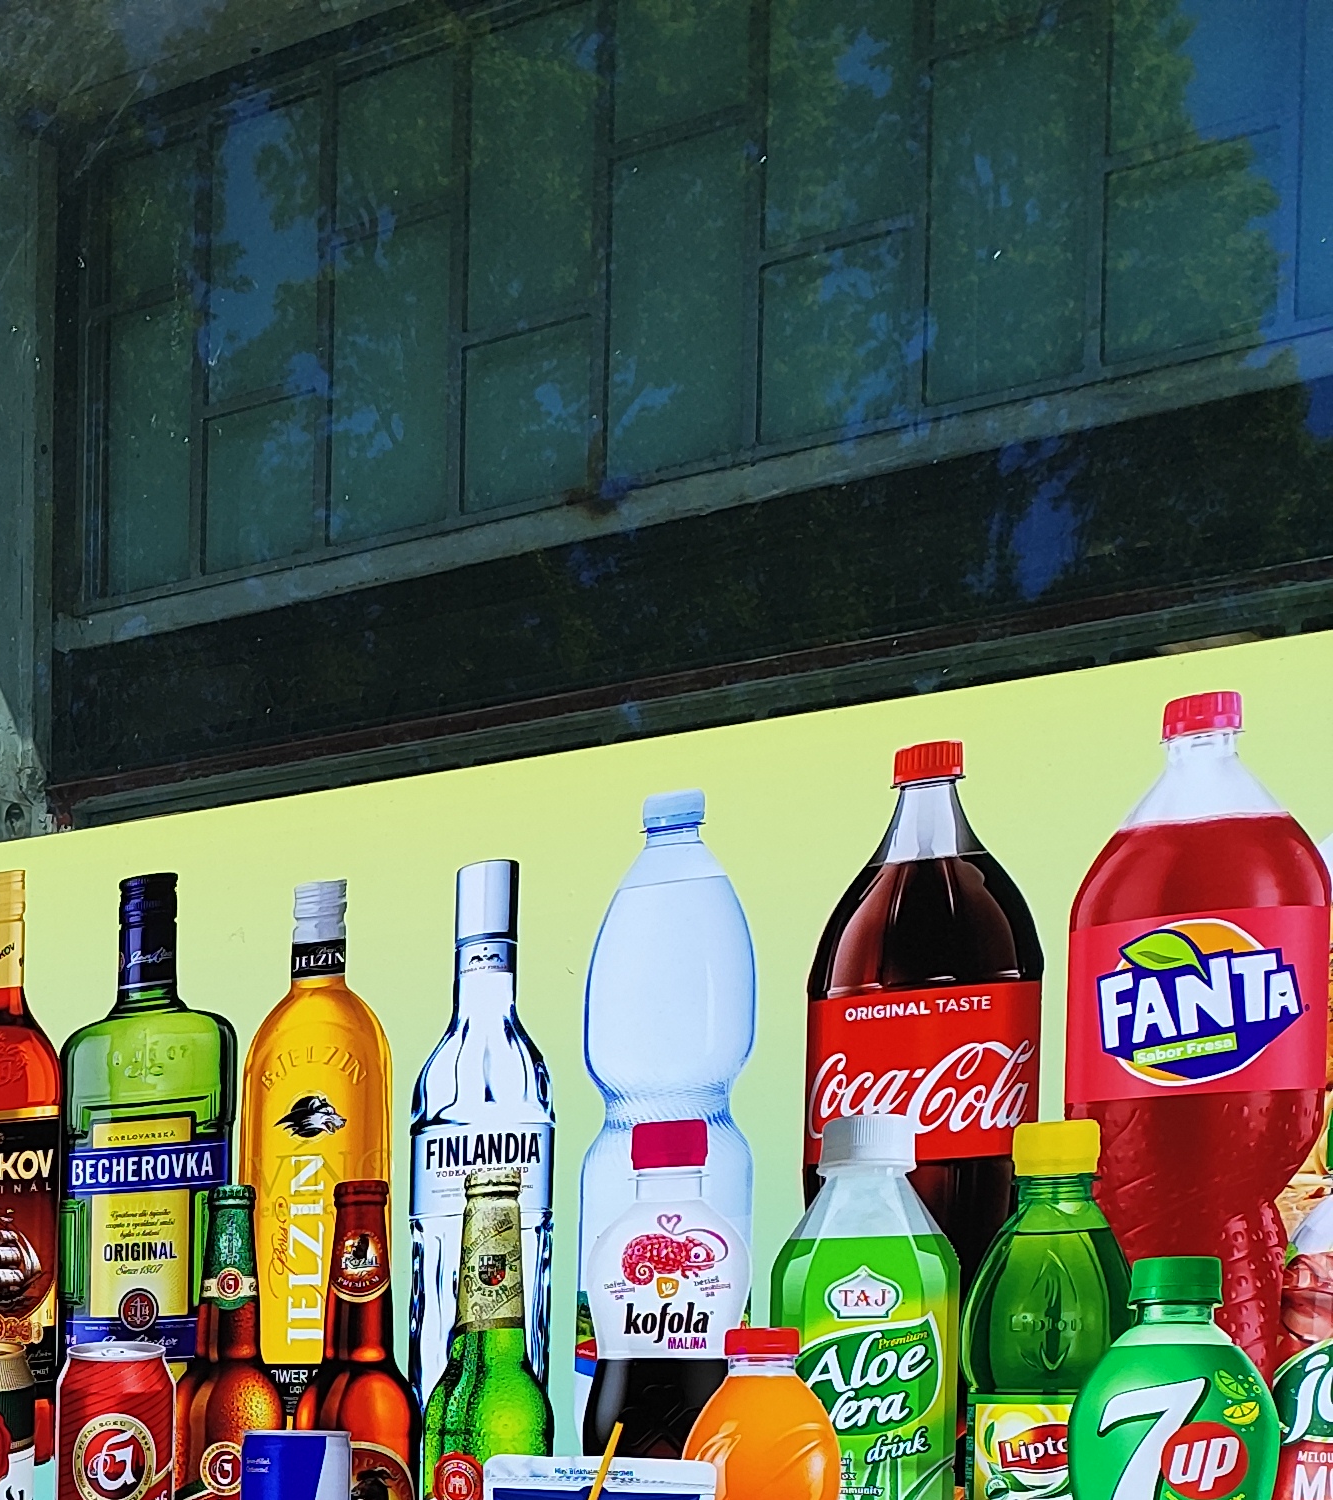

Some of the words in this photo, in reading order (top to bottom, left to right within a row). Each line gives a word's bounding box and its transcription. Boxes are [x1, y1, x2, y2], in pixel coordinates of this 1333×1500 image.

[293, 950, 345, 973] JELZIN
[845, 1000, 931, 1022] ORIGINAL
[935, 995, 992, 1015] TASTE
[1099, 952, 1299, 1050] FANTA
[1135, 1047, 1184, 1066] Sabor
[1186, 1037, 1233, 1054] Fresa
[807, 1039, 1036, 1141] Coca-Cola
[426, 1133, 541, 1170] FINLANDIA
[72, 1151, 214, 1186] BECHEROVKA
[436, 1169, 467, 1178] VODKA
[103, 1241, 178, 1262] ORIGINAL
[287, 1154, 325, 1345] JELZIN
[839, 1289, 888, 1307] TAJ
[624, 1302, 710, 1344] kofola
[668, 1337, 707, 1349] MALINA
[878, 1331, 928, 1350] Premium
[805, 1331, 932, 1392] Aloe
[866, 1426, 929, 1463] drink
